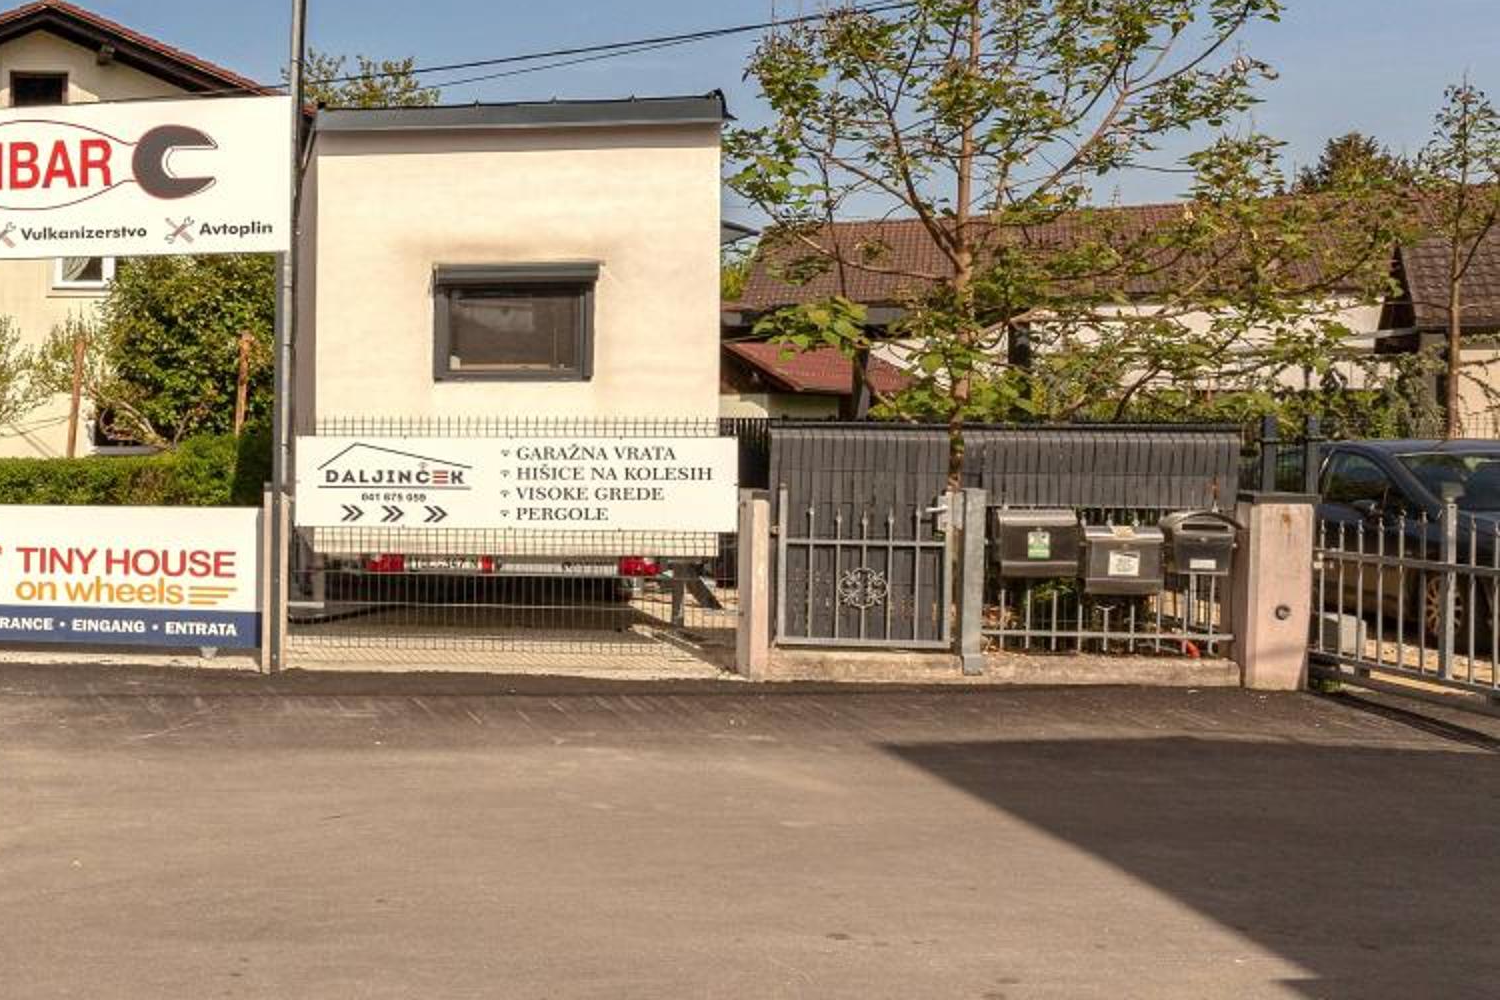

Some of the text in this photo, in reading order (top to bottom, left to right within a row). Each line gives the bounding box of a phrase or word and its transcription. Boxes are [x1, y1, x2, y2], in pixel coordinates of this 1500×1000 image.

[21, 226, 147, 240] Vulkanizerstvo
[199, 221, 273, 238] Avtoplin
[516, 444, 676, 460] GARAŽNA VRATA
[517, 464, 712, 480] HIŠICE NA KOLESIH
[516, 487, 664, 500] VISOKE GREDE
[516, 508, 608, 520] PERGOLE
[16, 547, 236, 578] TINY HOUSE
[15, 577, 185, 605] on wheels
[72, 618, 146, 633] EINGANG
[165, 622, 237, 636] ENTRATA
